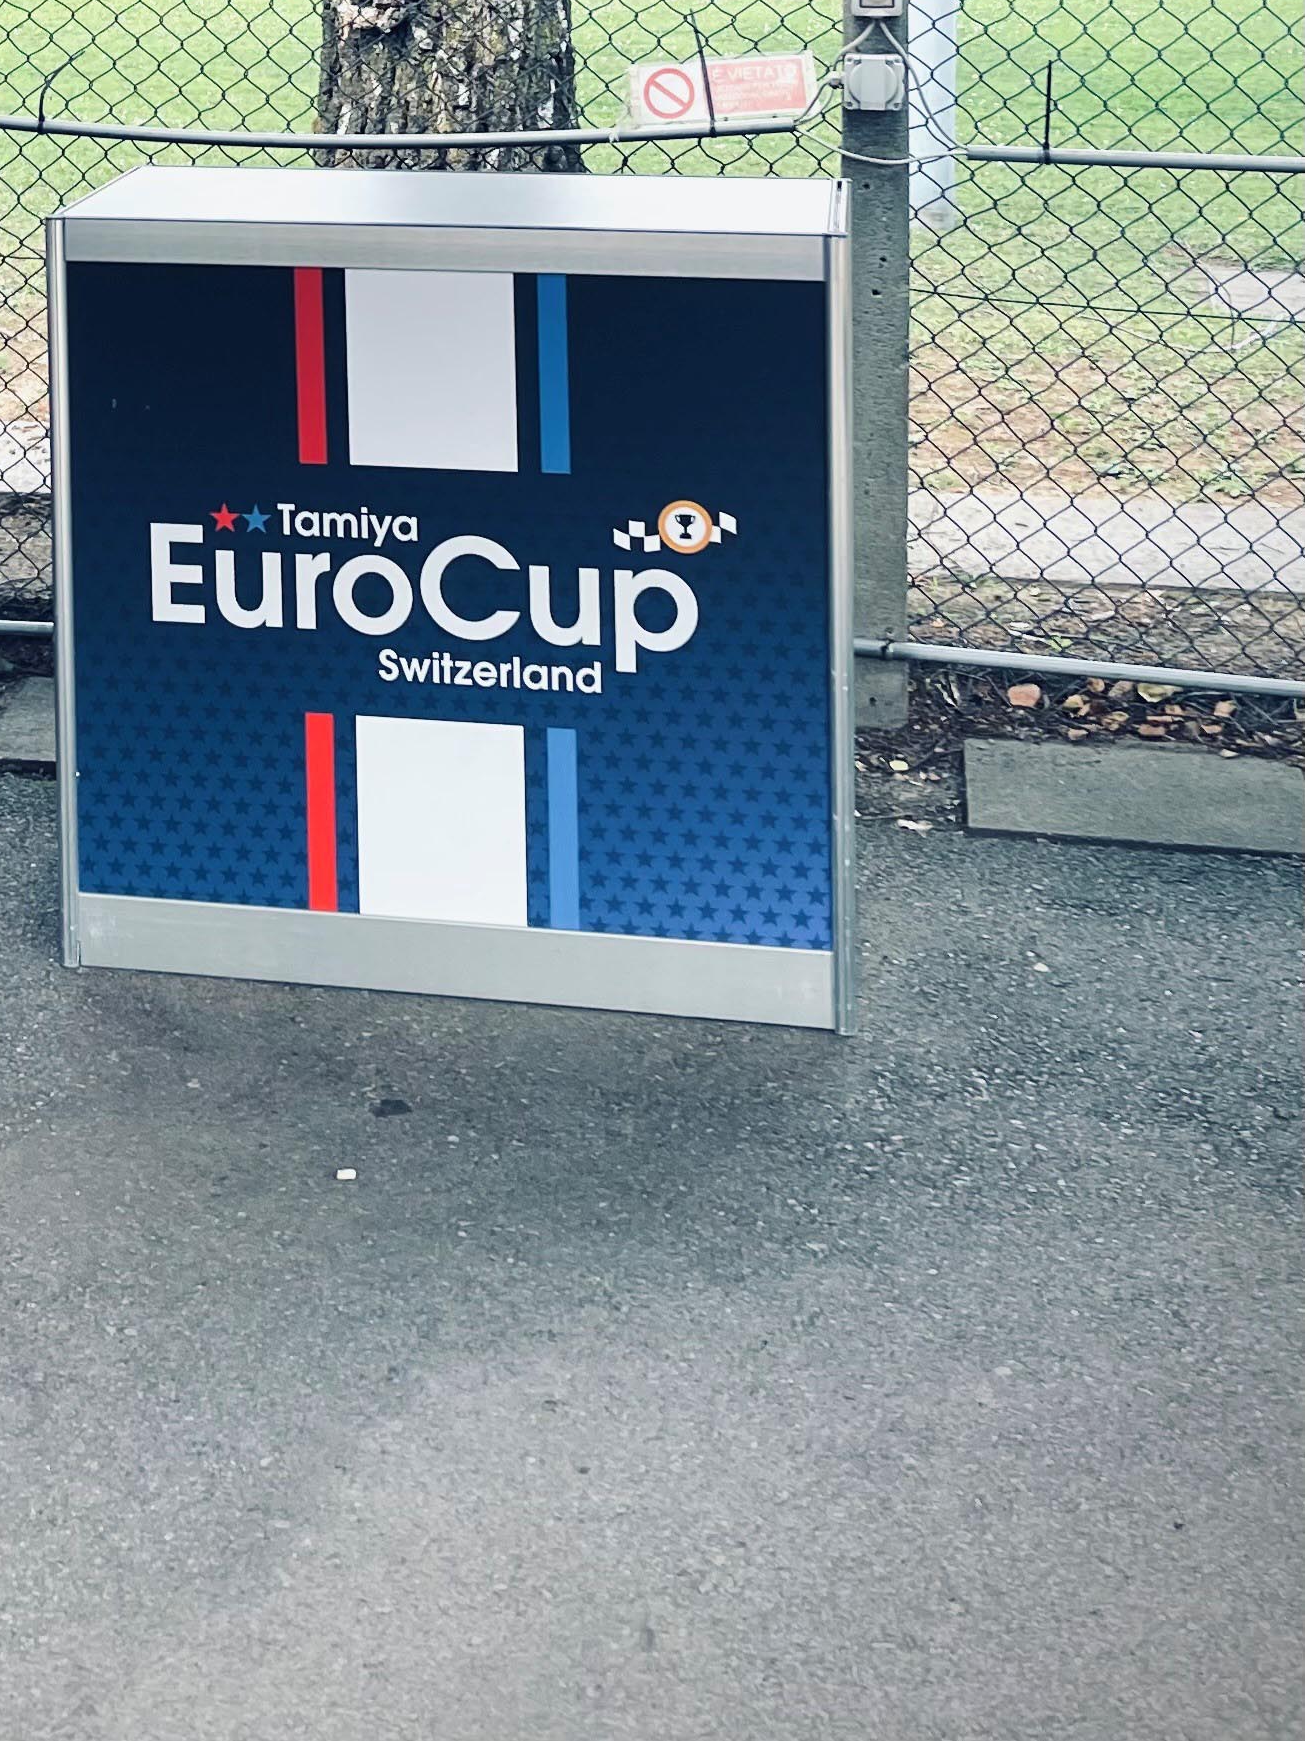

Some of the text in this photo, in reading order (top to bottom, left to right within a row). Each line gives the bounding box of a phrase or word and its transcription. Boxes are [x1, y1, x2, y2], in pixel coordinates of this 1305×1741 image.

[726, 63, 798, 82] VIETATO
[276, 502, 419, 548] Tamiya
[149, 521, 700, 674] EuroCup
[377, 647, 603, 695] Switzerland
